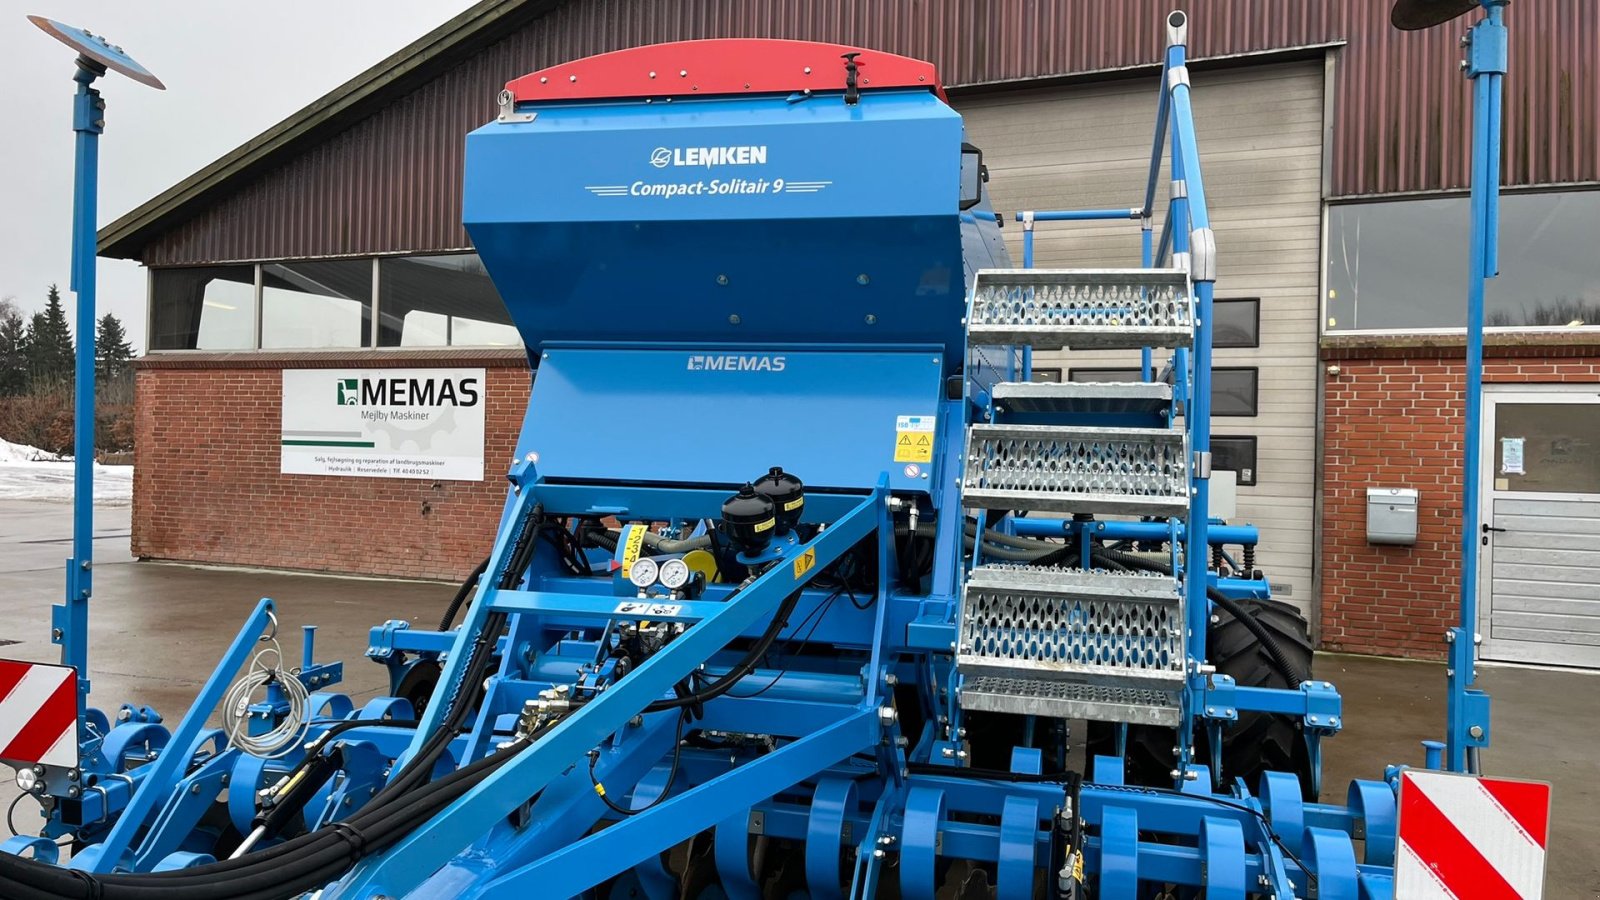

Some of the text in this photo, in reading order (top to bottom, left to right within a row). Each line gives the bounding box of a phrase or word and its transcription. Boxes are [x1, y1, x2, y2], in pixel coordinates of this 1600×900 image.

[674, 146, 767, 170] LEMKEN
[630, 178, 784, 199] Compact-Solitair 9
[704, 356, 786, 371] MEMAS
[361, 378, 479, 407] MEMAS
[361, 410, 430, 421] Mejlby Maskiner
[638, 527, 644, 535] 1
[633, 535, 642, 544] 2
[631, 544, 639, 553] 3
